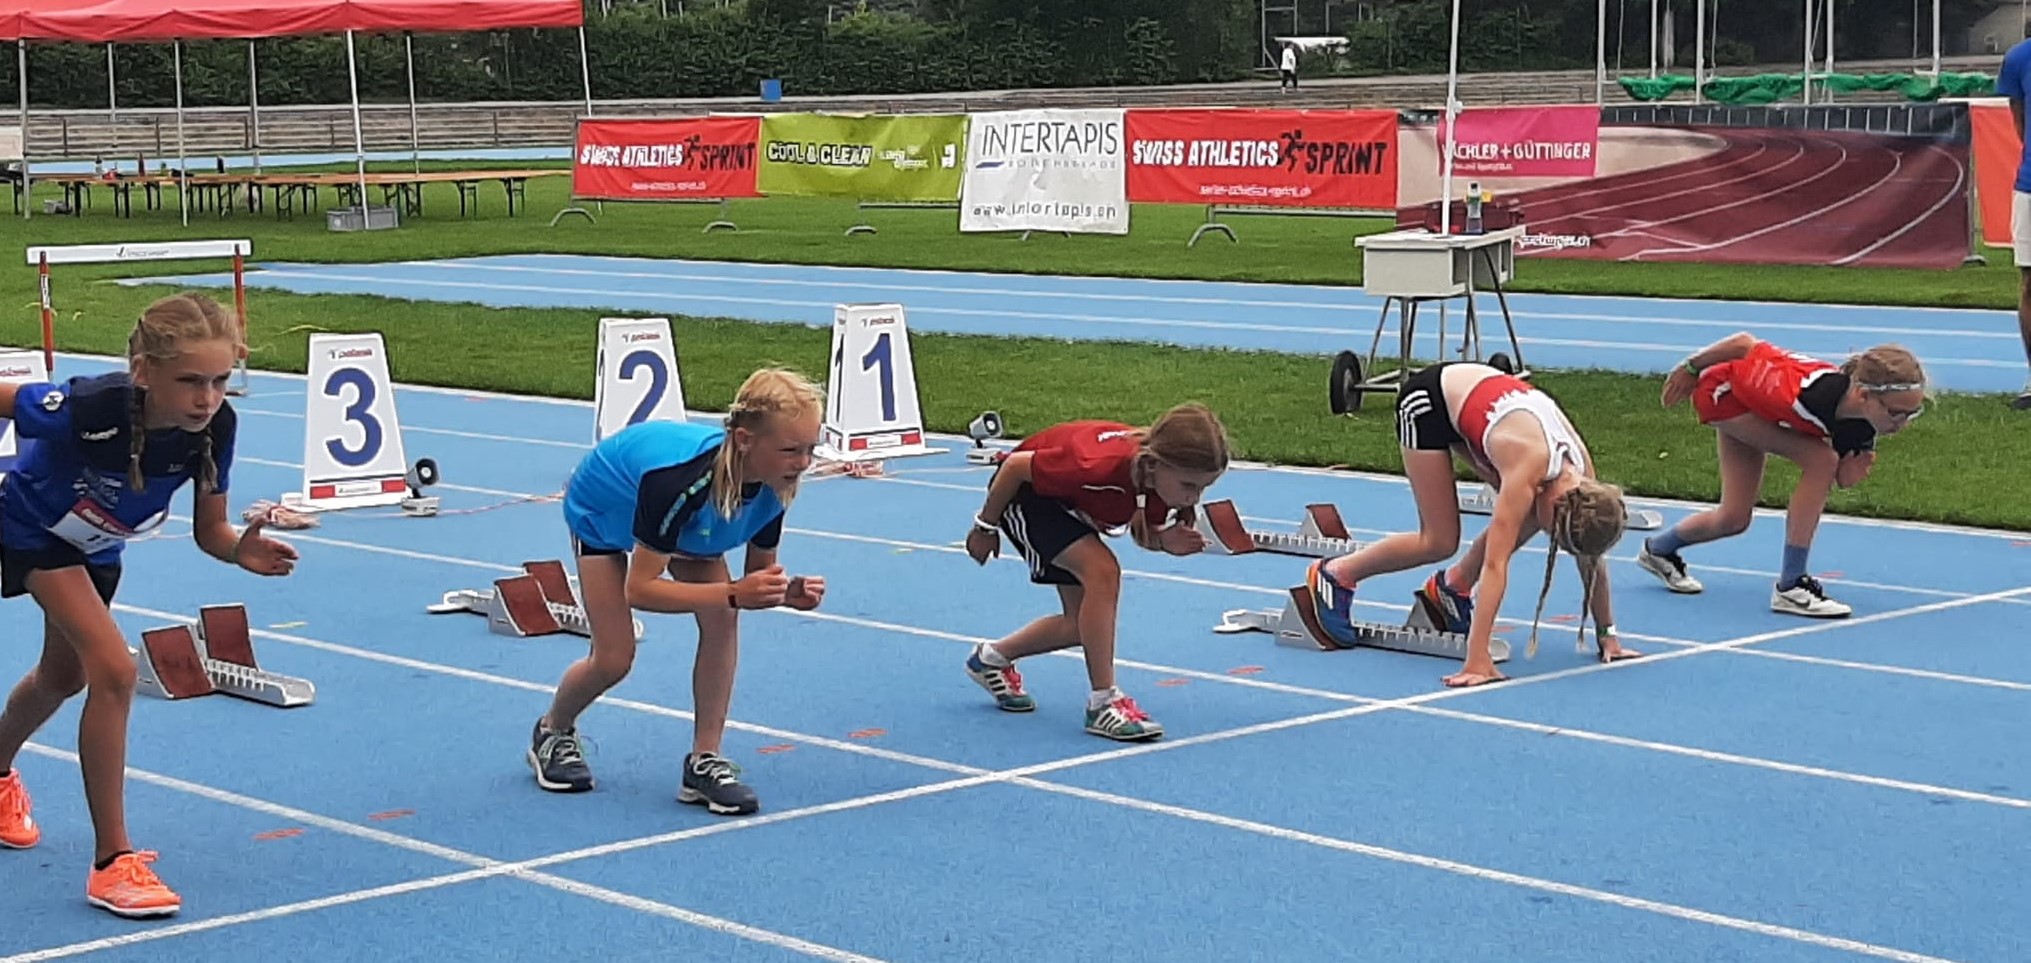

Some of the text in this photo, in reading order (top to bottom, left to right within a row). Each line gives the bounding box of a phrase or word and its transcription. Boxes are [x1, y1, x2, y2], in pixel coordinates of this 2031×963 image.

[767, 141, 804, 164] COOL
[819, 144, 874, 168] CLEAN
[982, 121, 1119, 156] INTERTAPIS
[1500, 143, 1512, 160] +
[1513, 139, 1592, 161] GÜTTINGER
[621, 143, 684, 168] ATHLETICS
[700, 141, 756, 172] SPRINT
[1132, 139, 1388, 175] SWISS ATHLETICS SPRINT
[619, 349, 668, 427] 2
[862, 332, 897, 422] 1
[323, 366, 383, 468] 3
